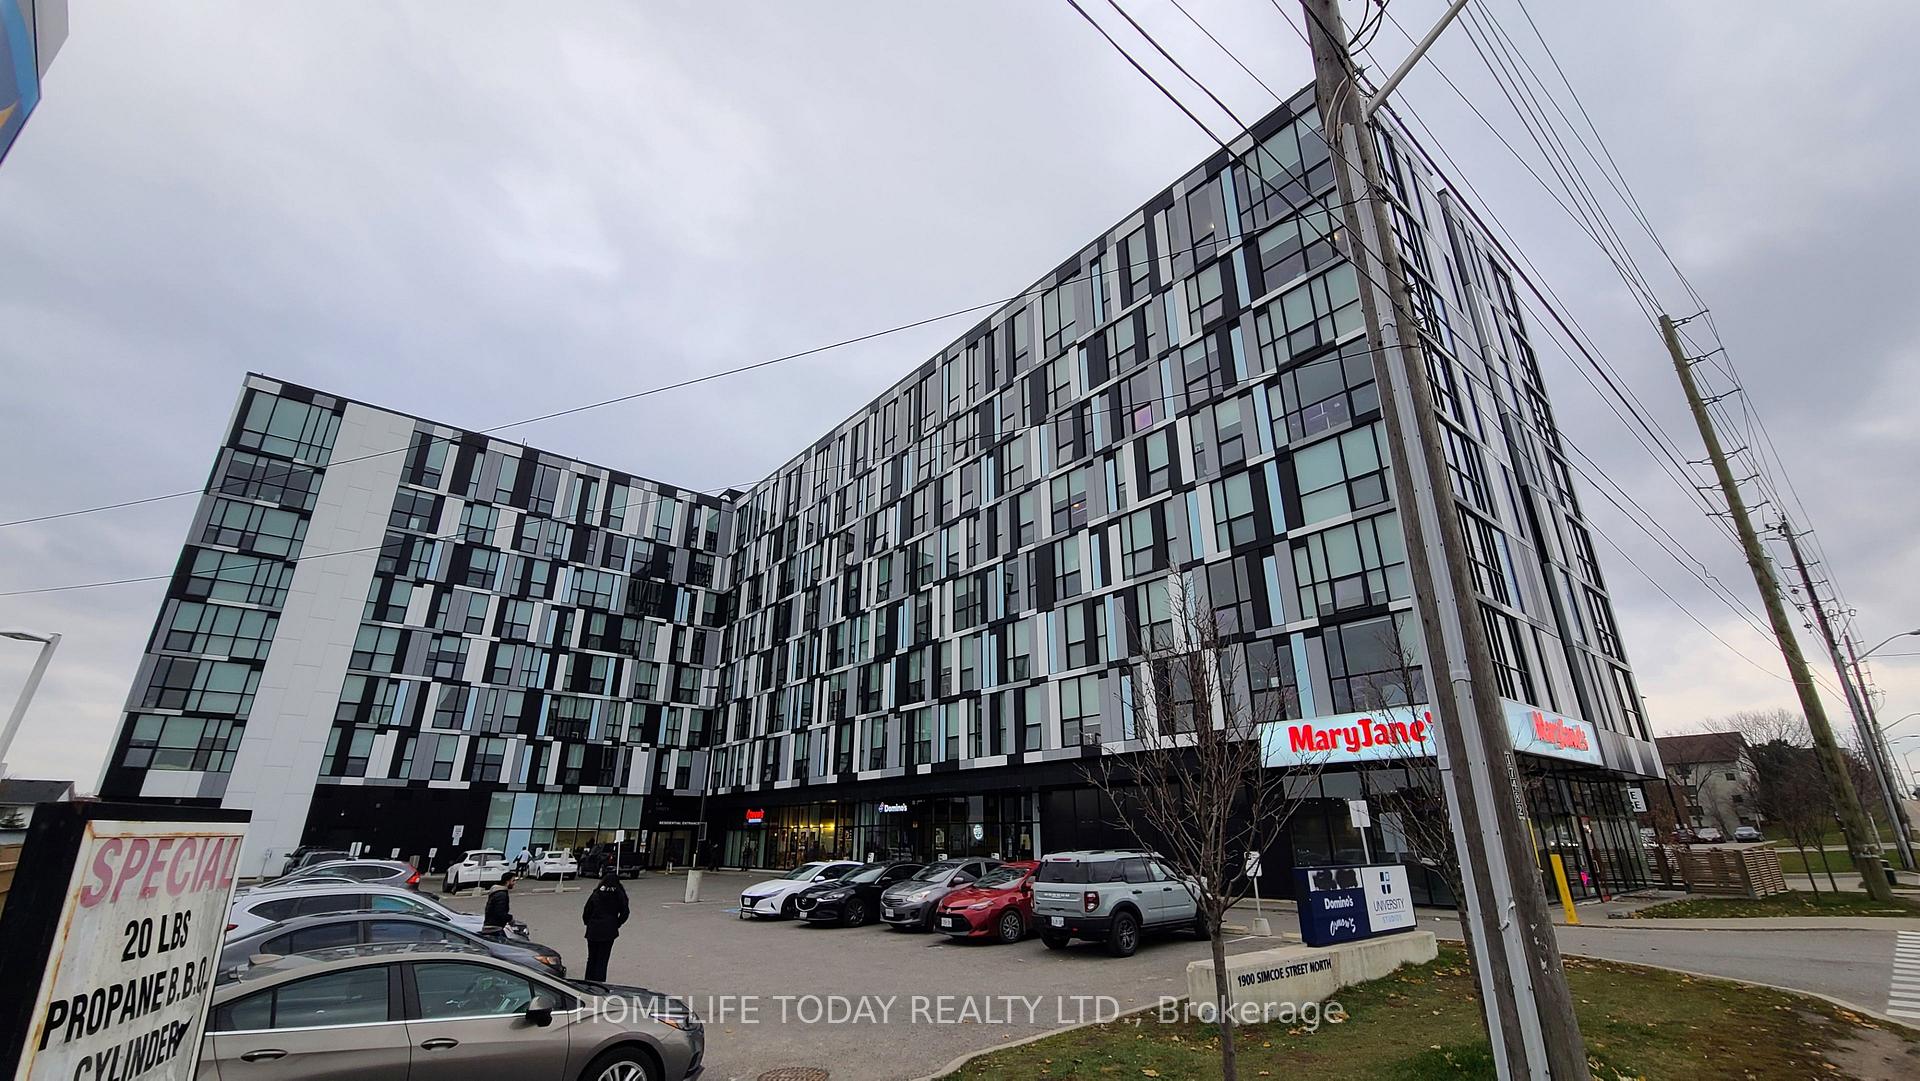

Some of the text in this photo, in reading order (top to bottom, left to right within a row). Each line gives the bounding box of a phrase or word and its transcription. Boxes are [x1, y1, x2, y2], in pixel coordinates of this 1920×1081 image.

[1288, 711, 1433, 753] MaryJane'
[884, 802, 908, 813] Domino's
[79, 837, 238, 907] SPECIAL
[1324, 895, 1354, 910] Domino's
[1373, 898, 1405, 913] UNIVERSITY
[121, 909, 192, 962] 20 LBS
[1237, 958, 1332, 988] 1900 SIMCOE STREET NORTH
[37, 970, 167, 1053] PROPANE
[72, 1019, 182, 1081] CYLINDER
